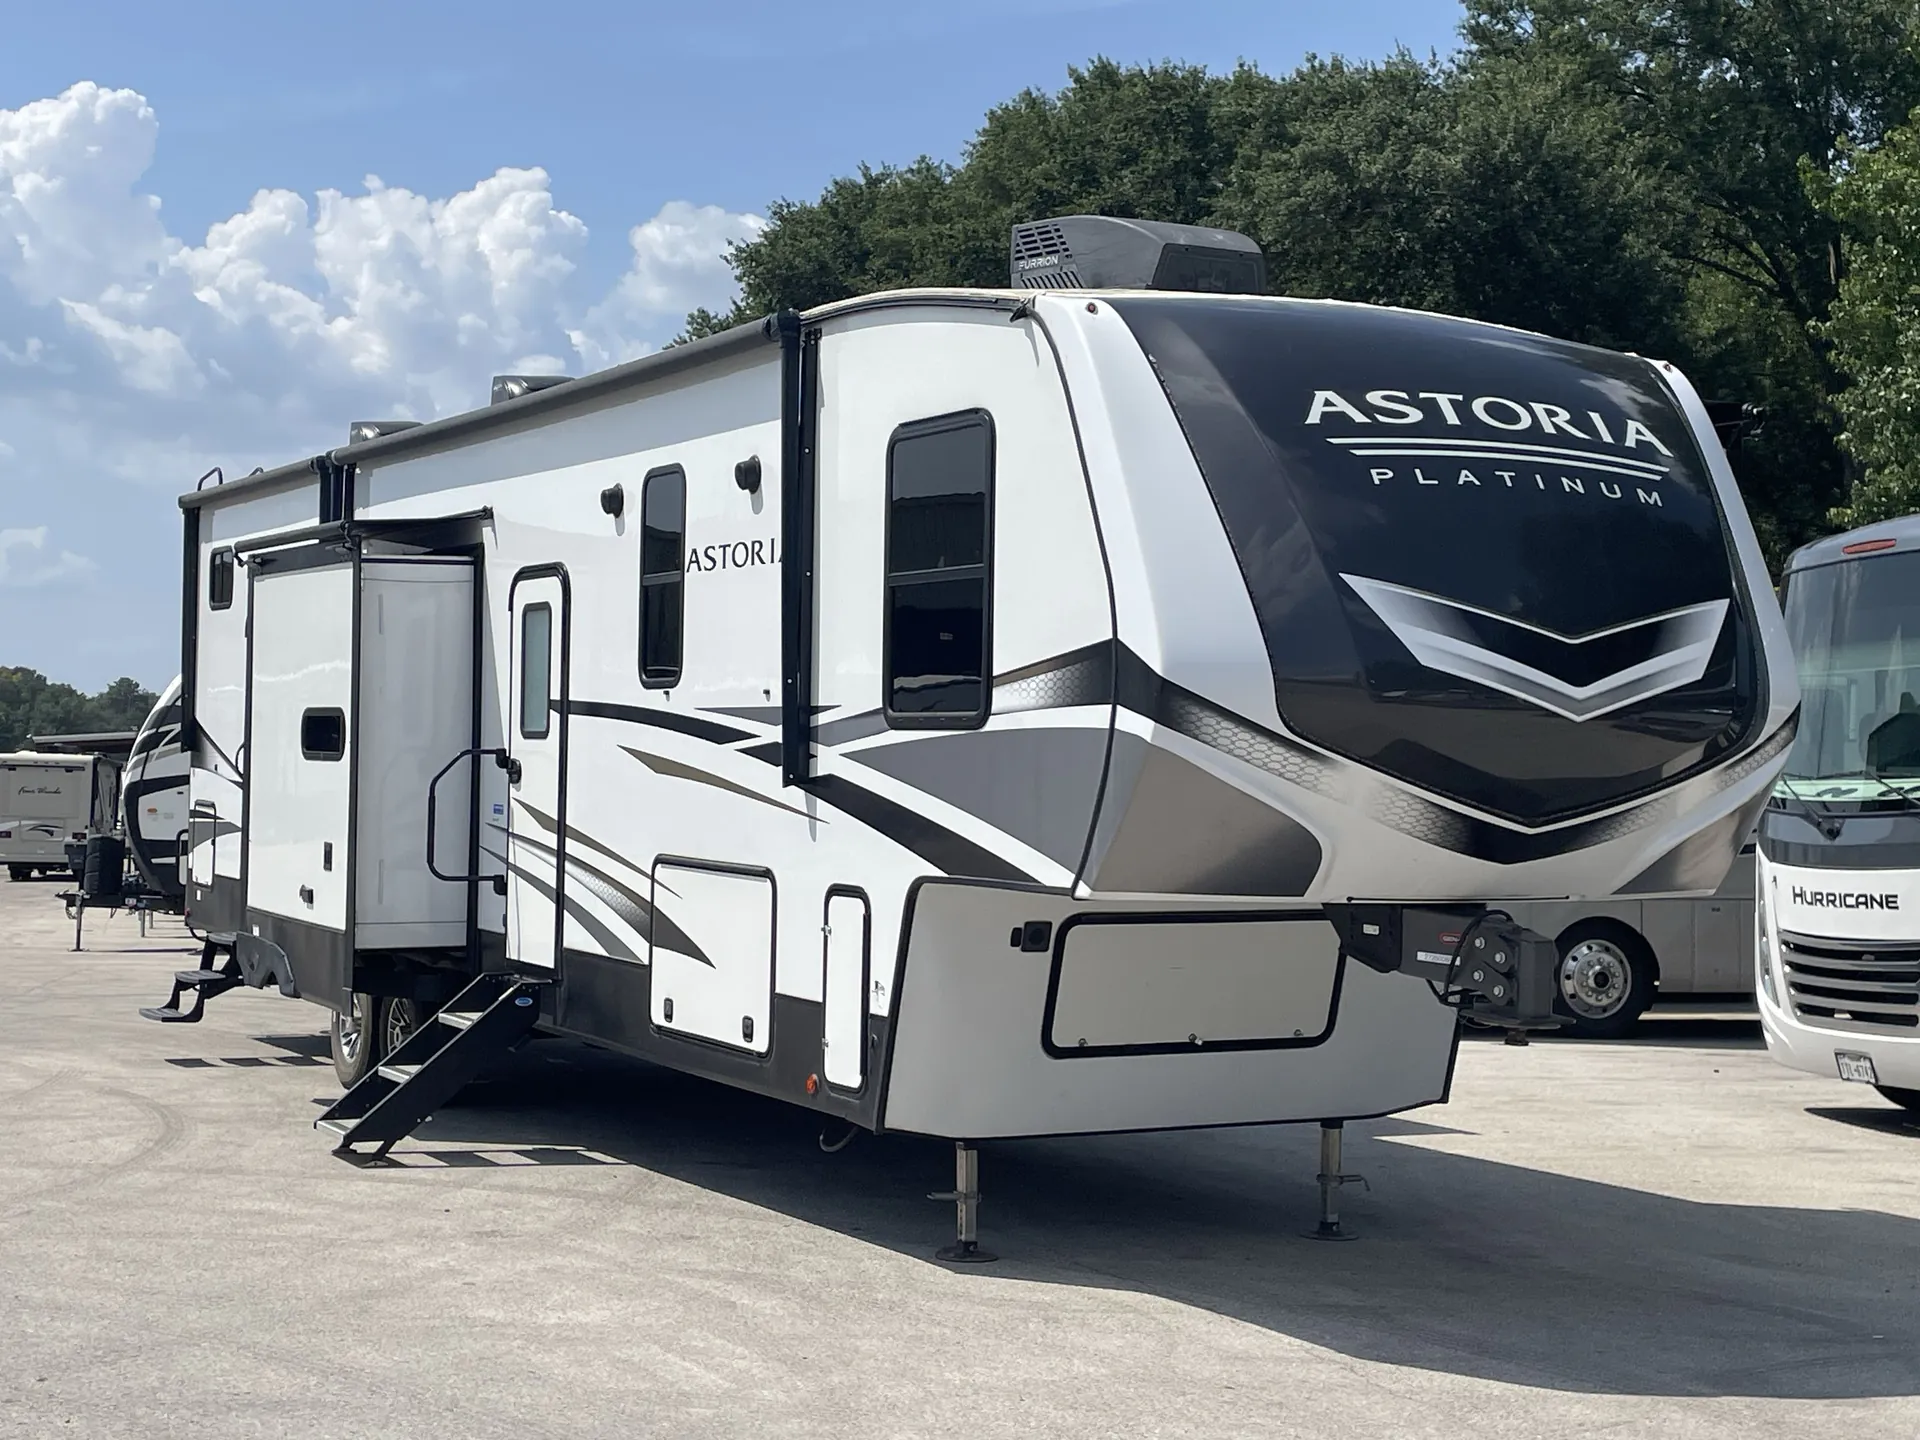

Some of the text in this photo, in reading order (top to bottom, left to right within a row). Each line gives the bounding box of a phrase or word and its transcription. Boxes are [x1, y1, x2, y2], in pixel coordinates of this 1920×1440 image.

[1018, 255, 1059, 270] FURRION
[1303, 389, 1674, 457] ASTORIA
[1369, 468, 1663, 507] PLATINUM
[686, 538, 782, 573] ASTORI
